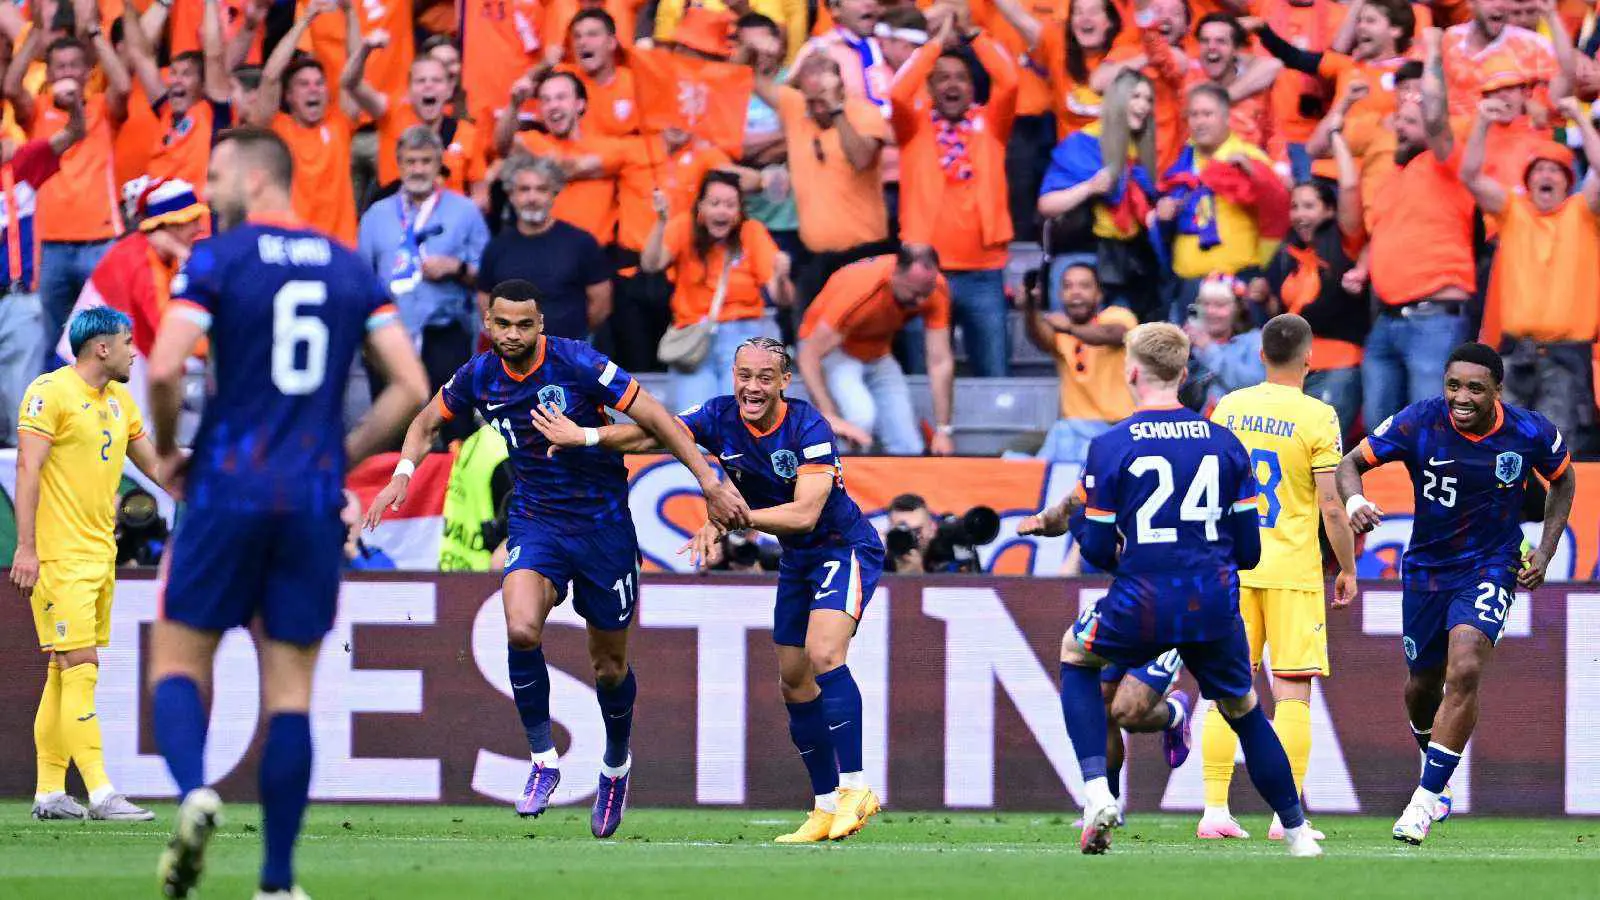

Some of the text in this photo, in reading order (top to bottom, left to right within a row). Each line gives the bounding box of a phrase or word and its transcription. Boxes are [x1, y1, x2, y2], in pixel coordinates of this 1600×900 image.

[271, 279, 330, 396] 6
[1129, 420, 1211, 441] SCHOUTEN
[1242, 414, 1296, 438] MARIN
[101, 430, 112, 461] 2
[1128, 454, 1223, 545] 24
[1423, 469, 1458, 508] 25
[612, 572, 633, 610] 11
[820, 560, 841, 588] 7
[1474, 582, 1512, 621] 25
